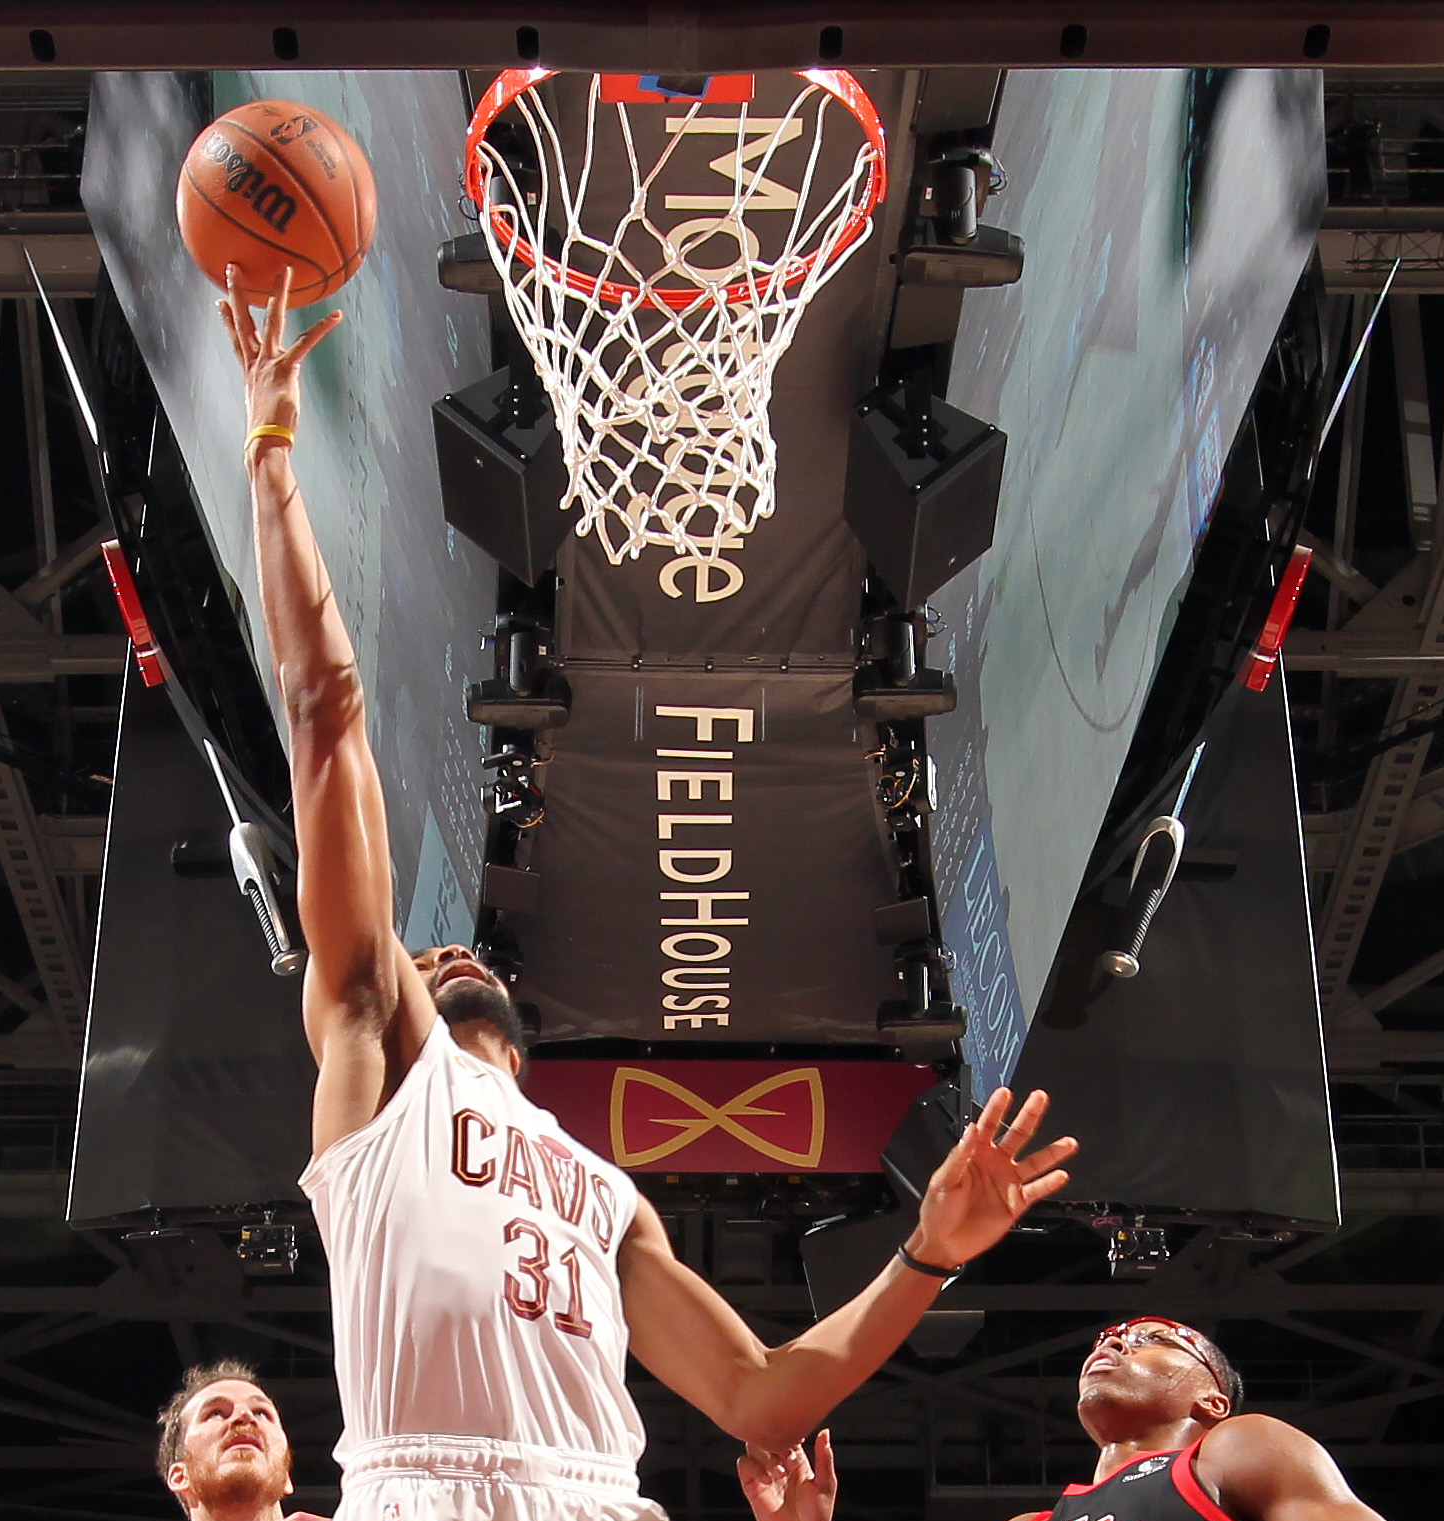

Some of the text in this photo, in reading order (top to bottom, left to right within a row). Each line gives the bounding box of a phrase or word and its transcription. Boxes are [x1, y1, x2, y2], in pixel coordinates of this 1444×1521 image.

[201, 131, 297, 234] Wilson
[627, 116, 804, 603] Motgage
[450, 1106, 617, 1253] CAVS
[502, 1216, 593, 1339] 31
